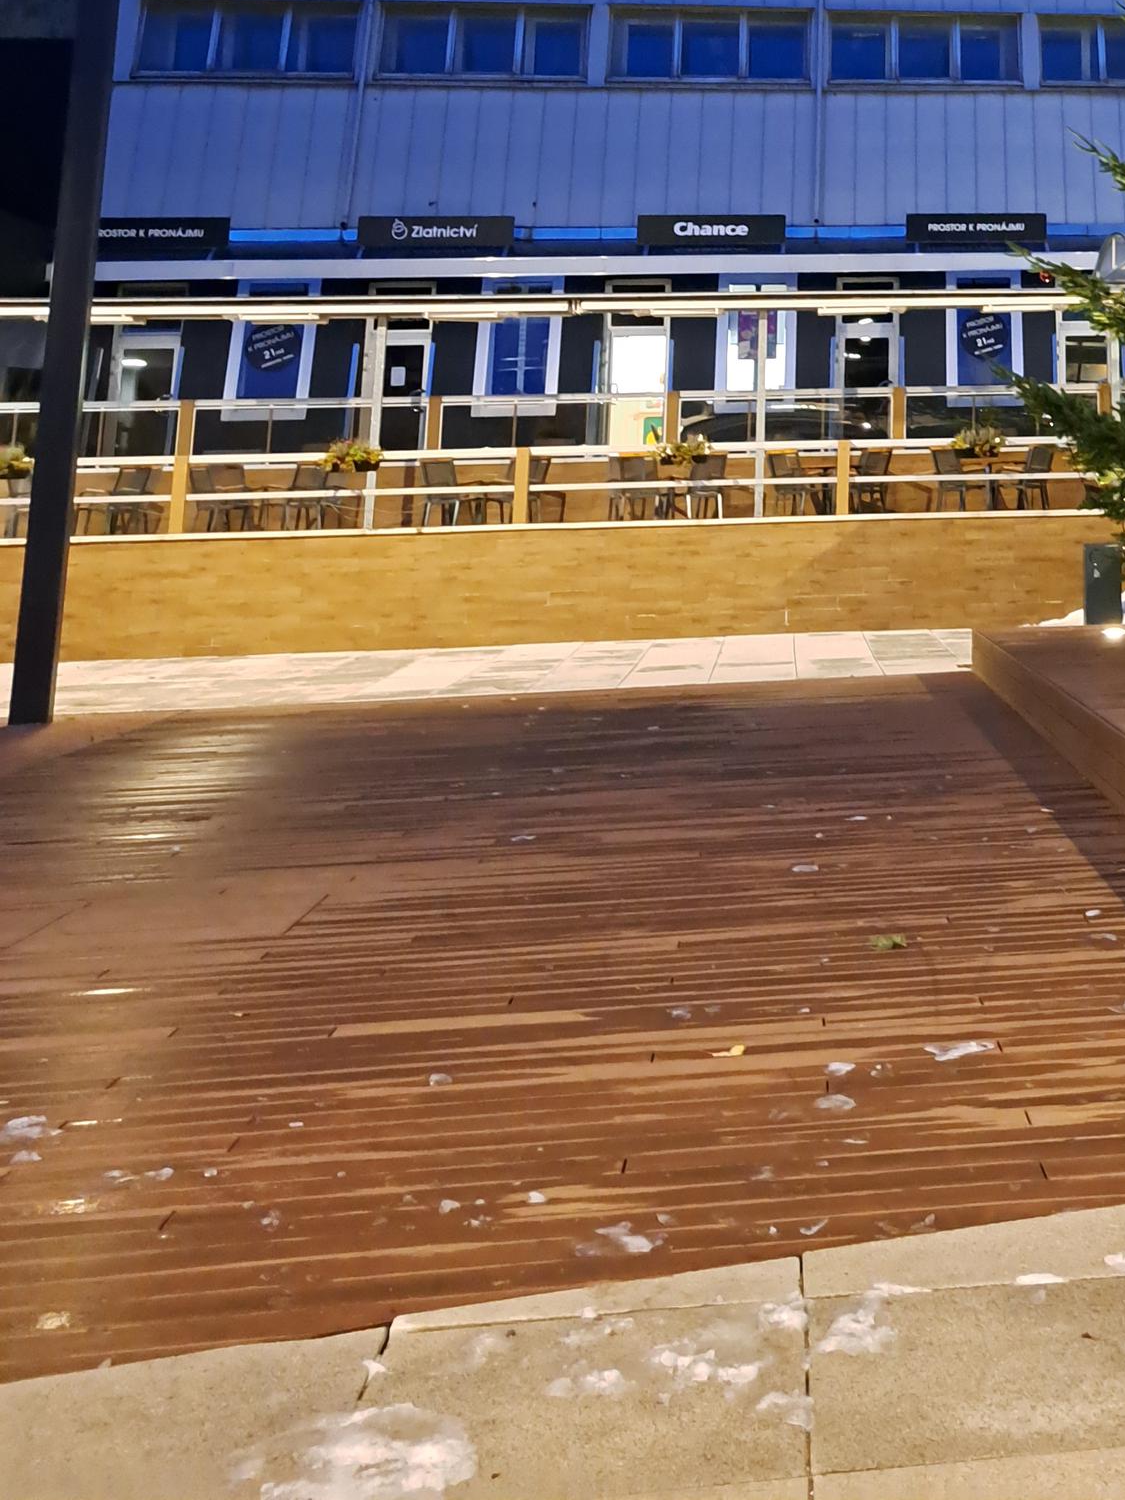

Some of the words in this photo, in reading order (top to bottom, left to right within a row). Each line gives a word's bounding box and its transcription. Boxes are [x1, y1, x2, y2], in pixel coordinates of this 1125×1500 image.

[98, 228, 137, 238] ROSTOR
[139, 229, 146, 238] K
[148, 226, 205, 238] PRONÁJMU
[411, 223, 478, 238] Zlatnictví
[673, 221, 749, 236] Chance
[927, 222, 967, 232] PROSTOR
[968, 223, 975, 232] K
[976, 220, 1025, 232] PRONÁJMU
